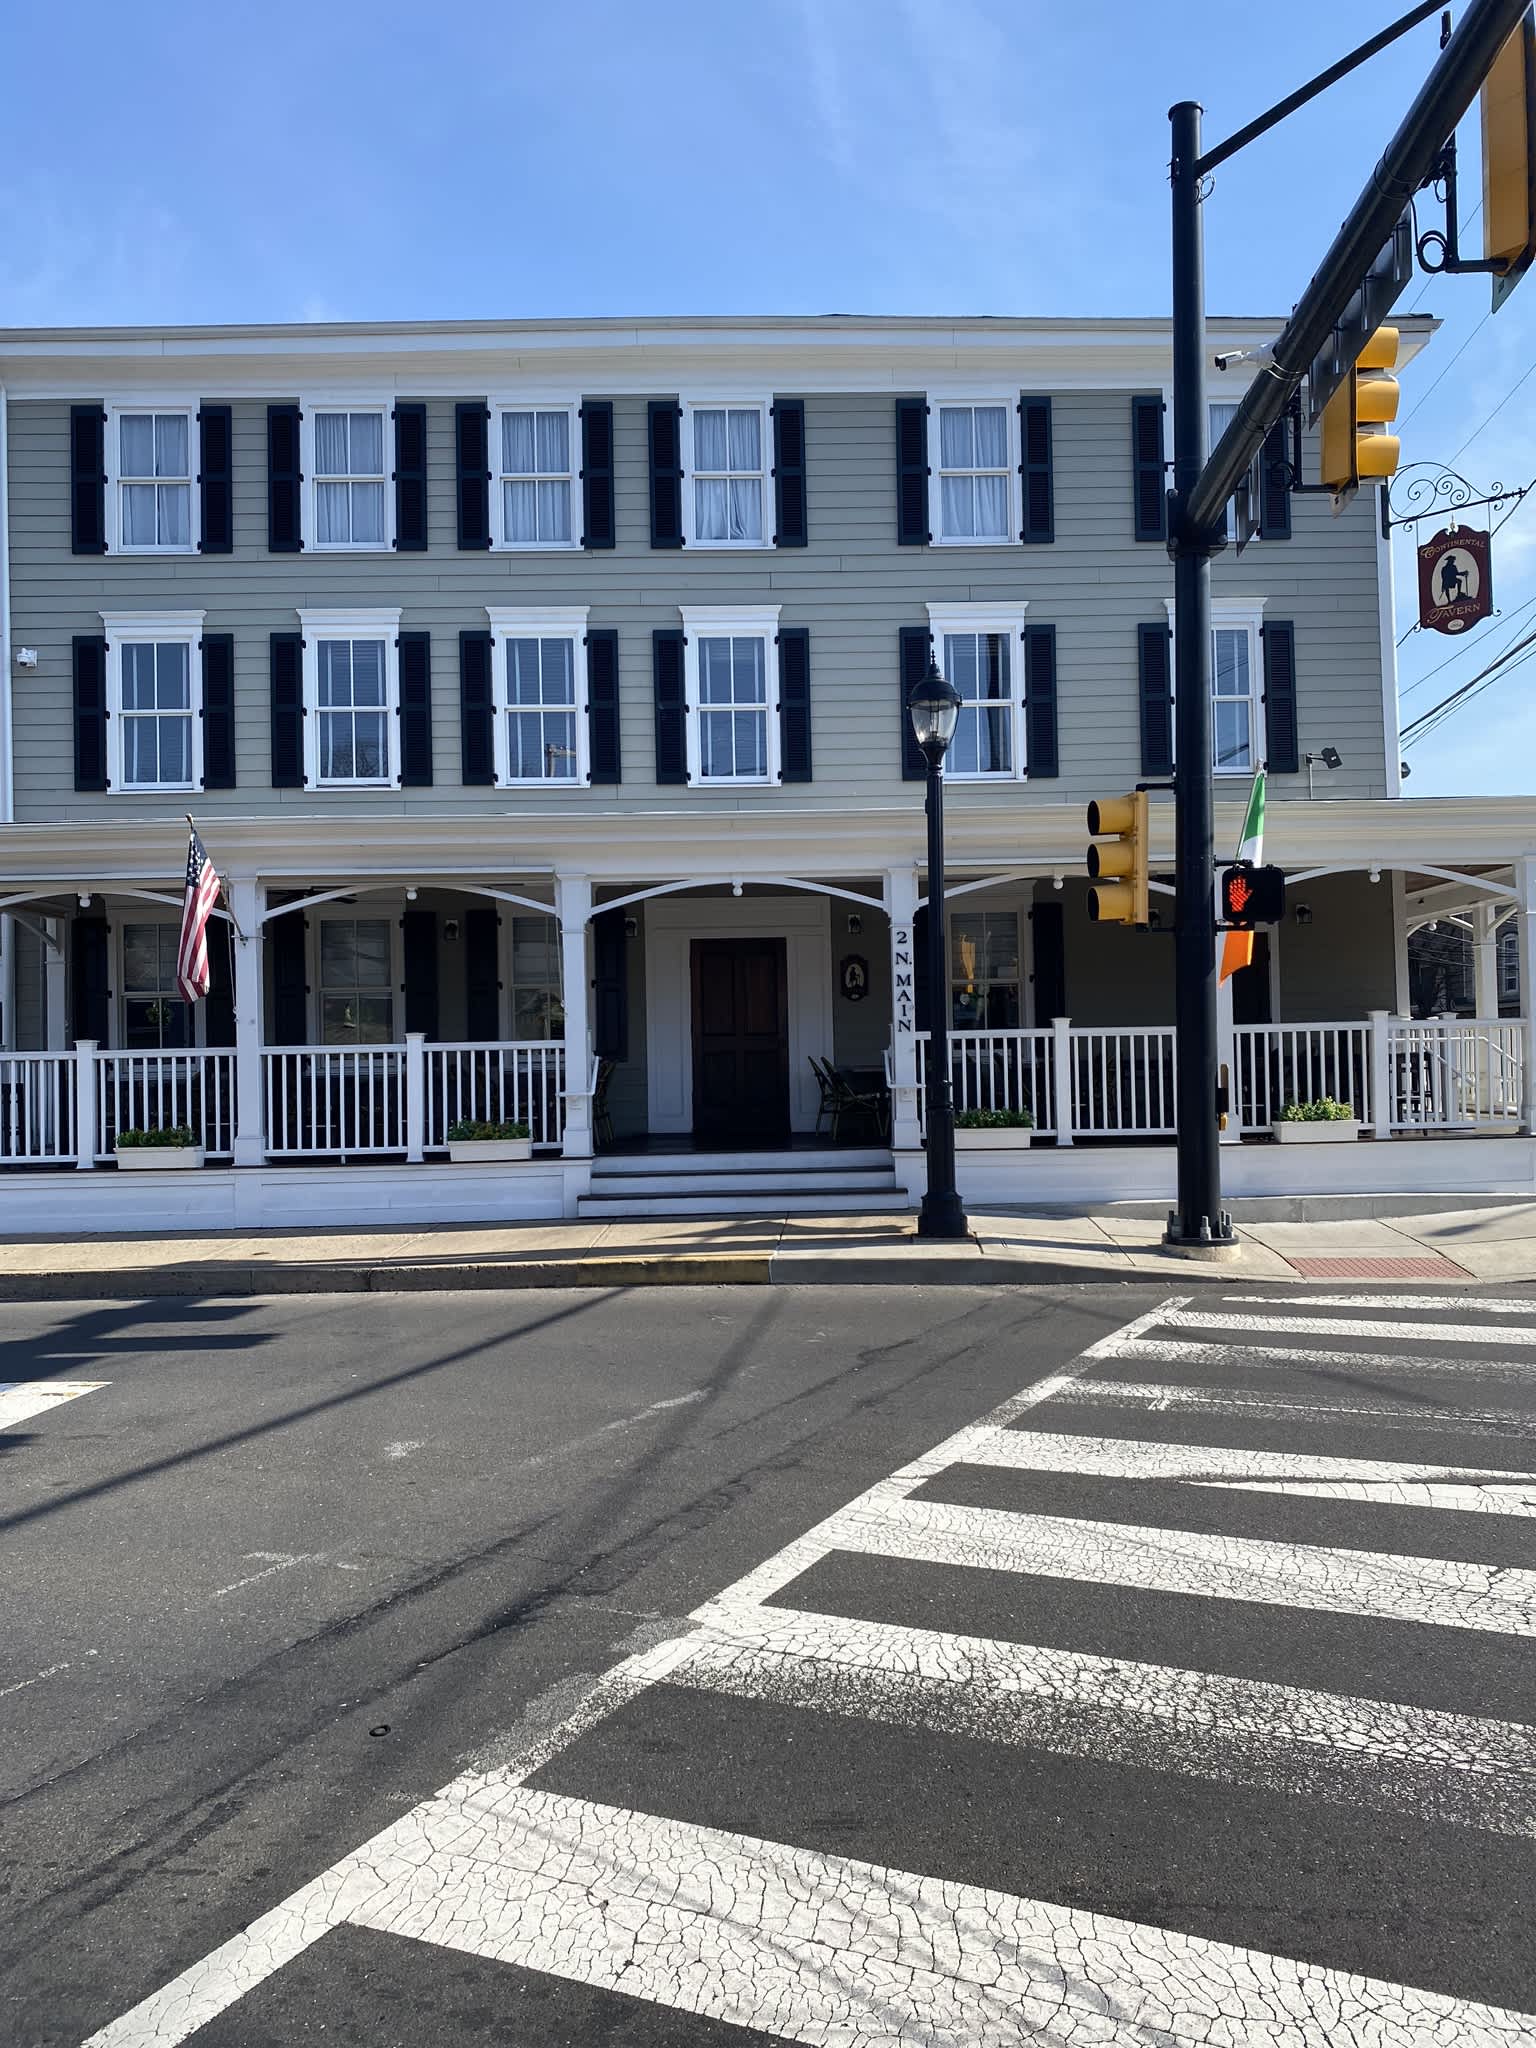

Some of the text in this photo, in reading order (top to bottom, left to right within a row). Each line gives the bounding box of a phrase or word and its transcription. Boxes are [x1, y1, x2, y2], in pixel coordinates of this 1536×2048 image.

[895, 931, 912, 1033] 2 N. MAIN
